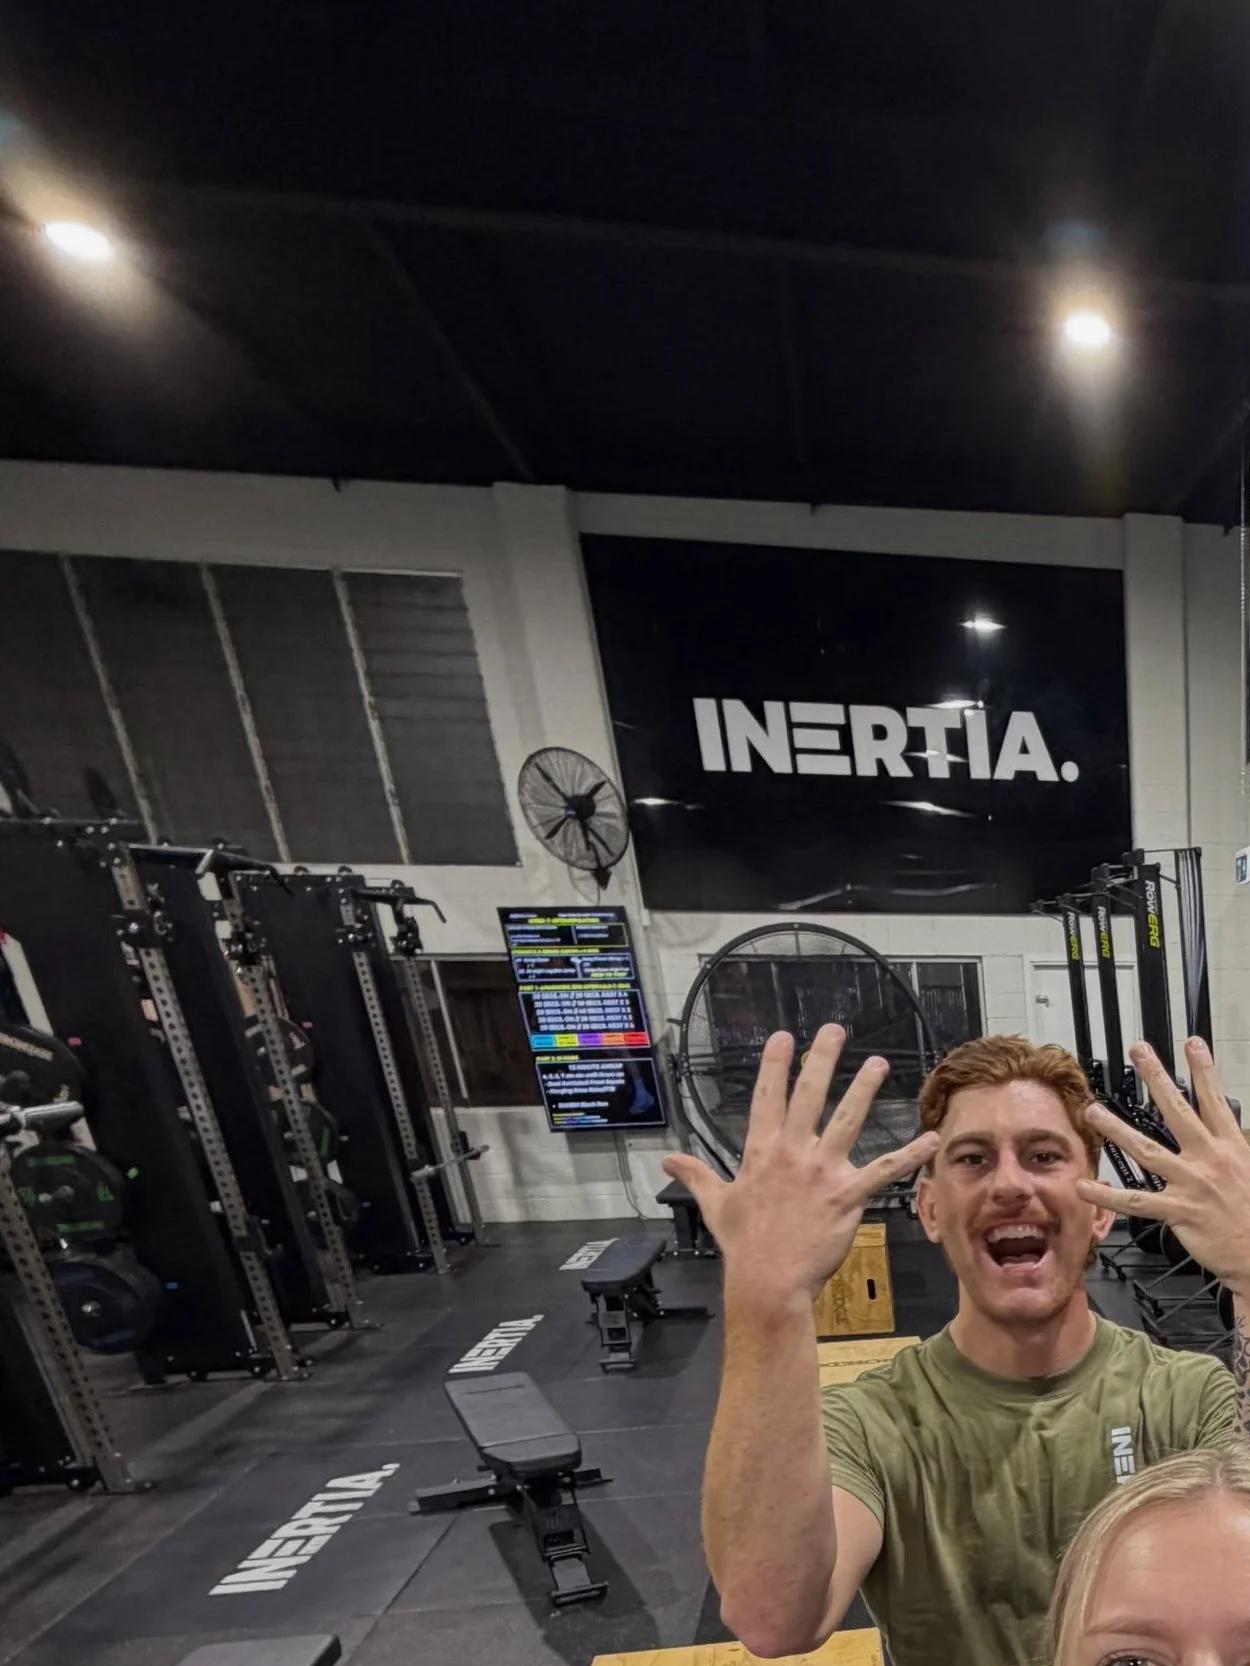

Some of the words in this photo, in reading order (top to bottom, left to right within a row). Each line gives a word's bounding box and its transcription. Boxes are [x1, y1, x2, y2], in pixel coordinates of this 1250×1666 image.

[692, 697, 1079, 783] INERTIA.
[447, 1315, 545, 1373] INERTIA.
[208, 1462, 401, 1596] INERTIA.
